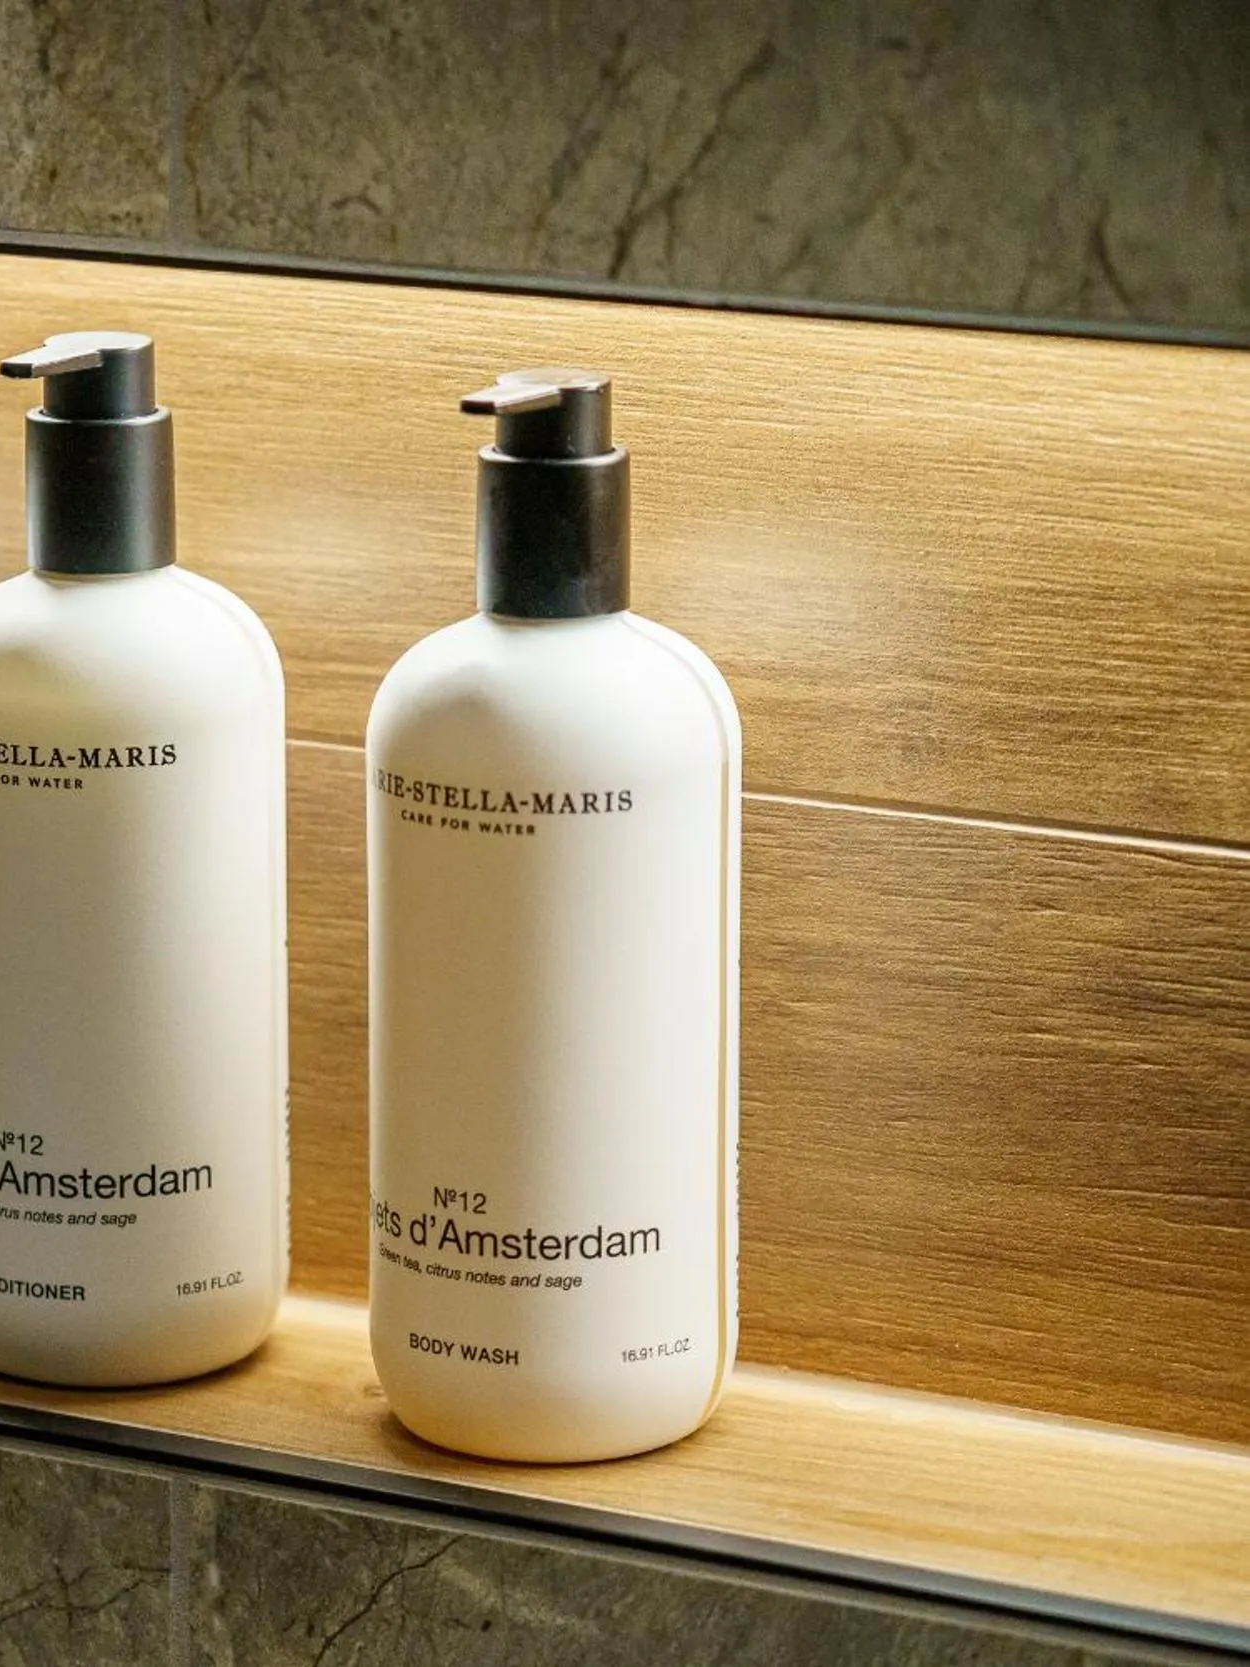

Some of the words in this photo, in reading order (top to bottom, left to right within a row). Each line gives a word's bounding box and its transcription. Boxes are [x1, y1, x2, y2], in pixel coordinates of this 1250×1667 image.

[29, 777, 84, 790] WATER
[373, 767, 633, 815] RIE-STELLA-MARIS
[401, 809, 433, 826] CARE
[441, 817, 470, 831] FOR
[479, 823, 536, 835] WATER
[24, 1208, 63, 1224] notes
[67, 1211, 97, 1225] and
[101, 1213, 137, 1228] sage
[372, 1199, 402, 1237] ets
[409, 1213, 660, 1261] d'Amsterdam
[176, 1279, 208, 1297] 16.91
[426, 1262, 462, 1281] citrus
[465, 1270, 507, 1287] notes
[510, 1274, 541, 1288] and
[545, 1275, 583, 1291] sage
[409, 1333, 454, 1357] BODY
[461, 1345, 519, 1365] WASH
